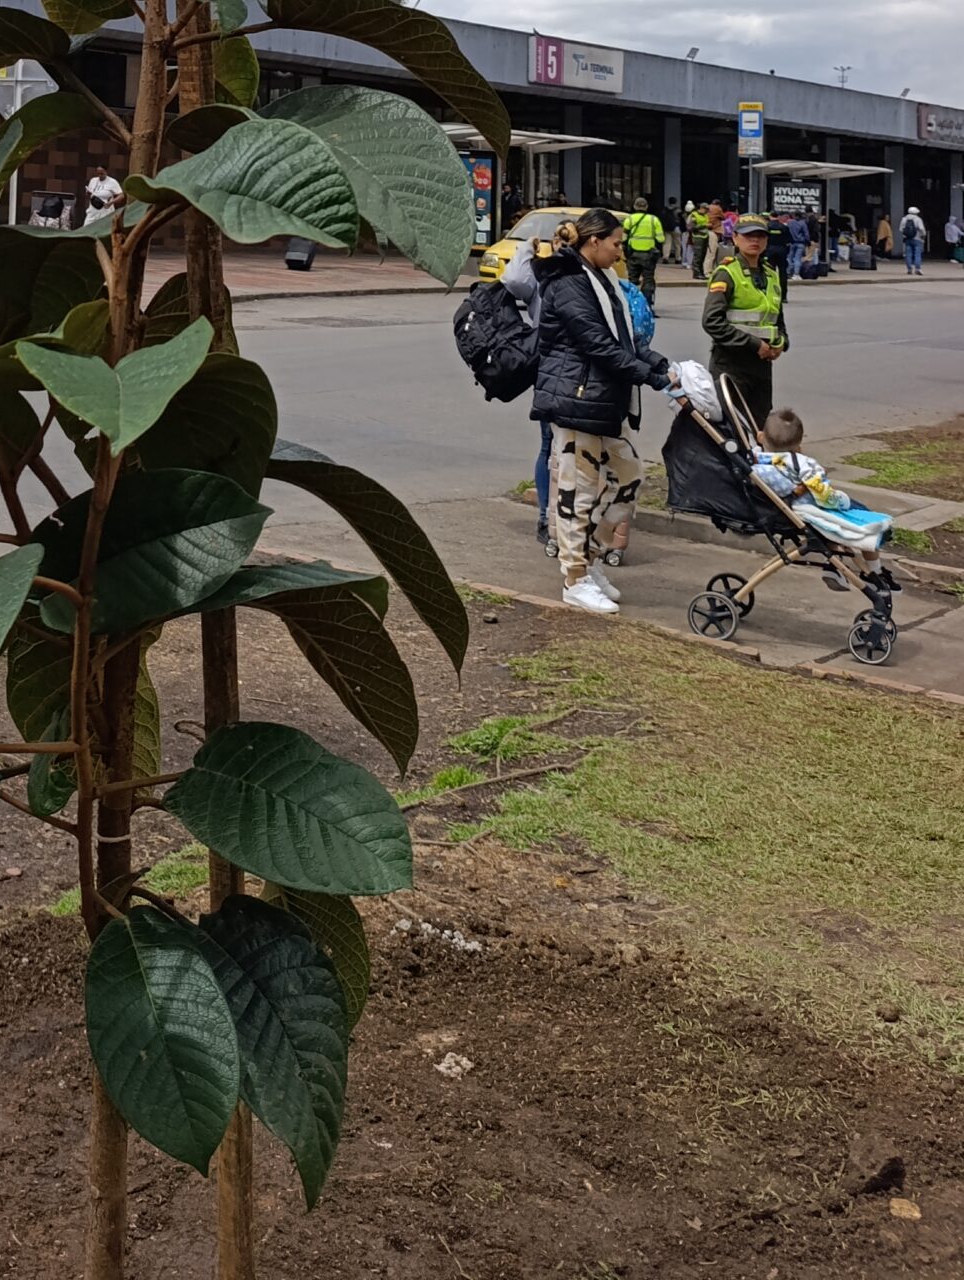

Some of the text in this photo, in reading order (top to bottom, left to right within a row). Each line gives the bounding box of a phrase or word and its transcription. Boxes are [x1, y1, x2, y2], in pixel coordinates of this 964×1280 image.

[547, 45, 557, 80] 5
[774, 186, 820, 197] HYUNDAI
[774, 195, 802, 204] KONA
